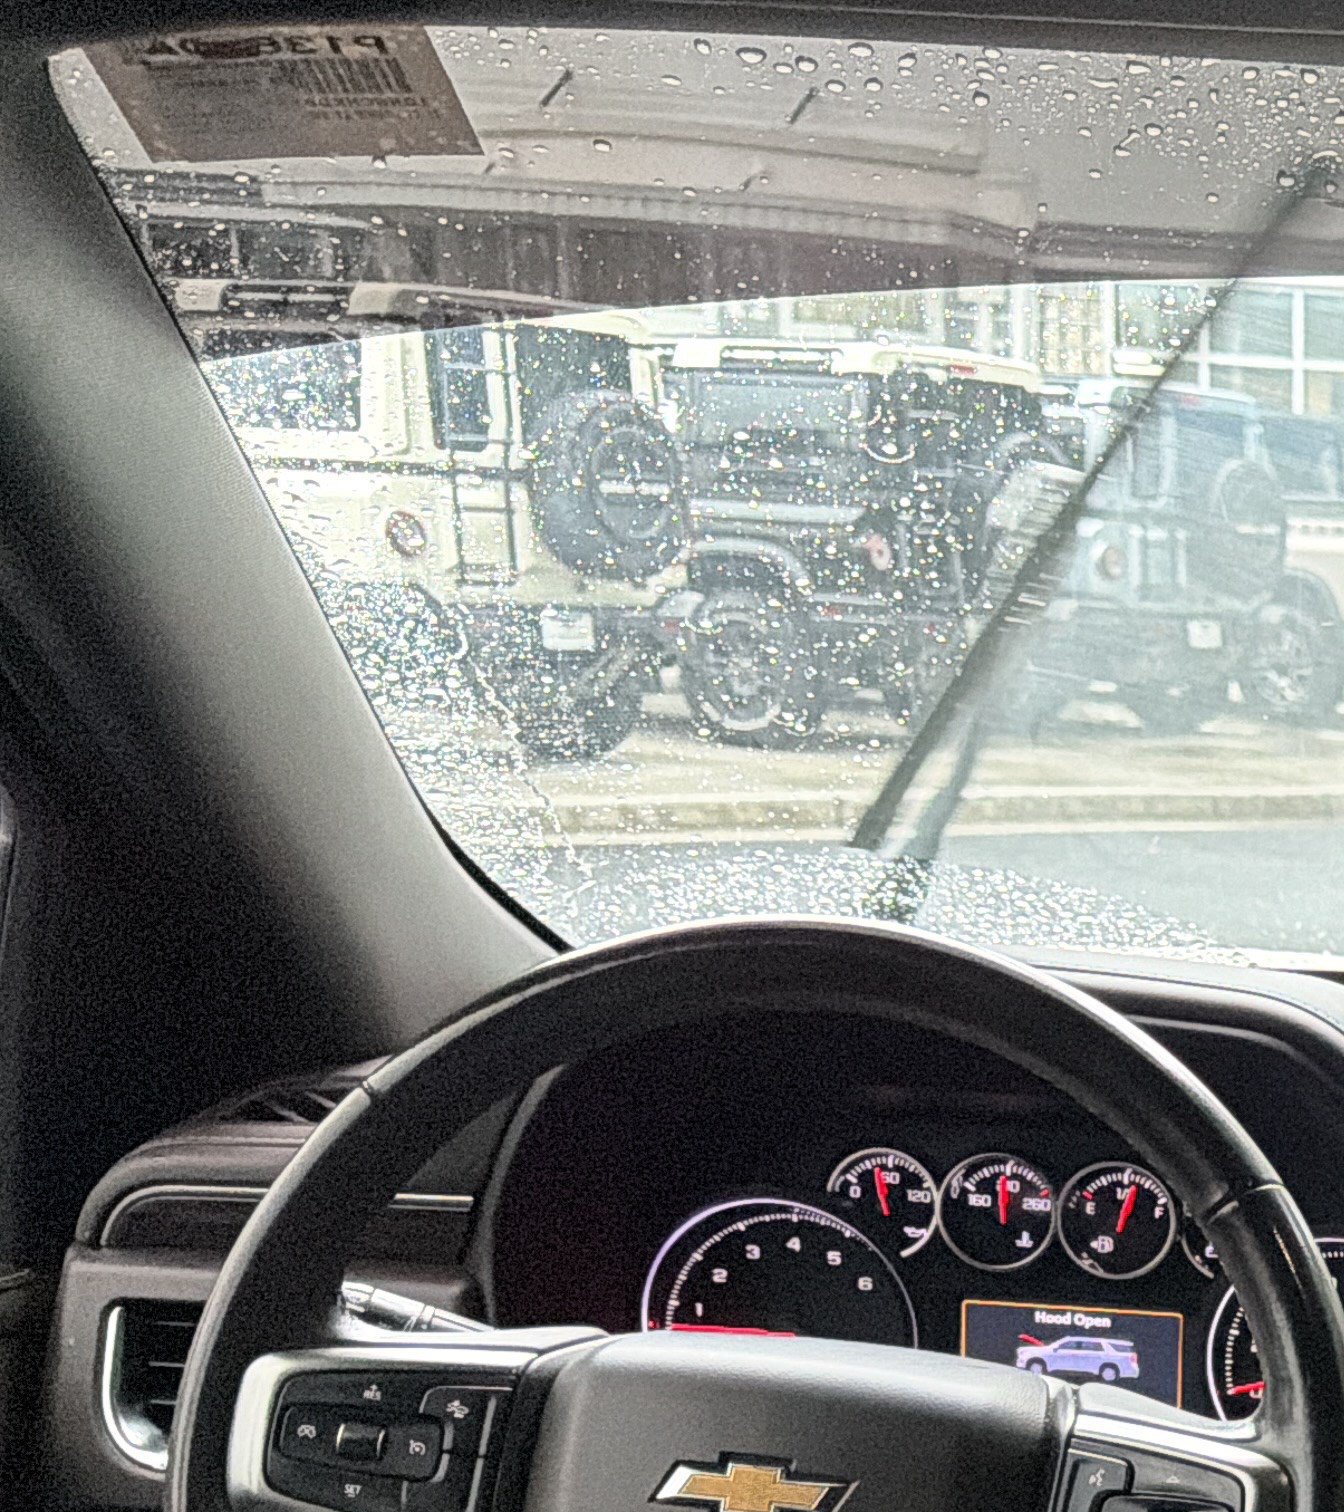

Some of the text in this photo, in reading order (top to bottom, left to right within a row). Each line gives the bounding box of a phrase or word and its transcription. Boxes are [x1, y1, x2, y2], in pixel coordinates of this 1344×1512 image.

[848, 1185, 861, 1199] 0
[906, 1189, 931, 1203] 120
[967, 1195, 992, 1208] 160
[1021, 1197, 1052, 1213] 260
[1085, 1202, 1096, 1215] E
[744, 1243, 761, 1260] 3
[785, 1235, 801, 1253] 4
[825, 1250, 843, 1266] 5
[711, 1267, 729, 1284] 2
[857, 1276, 874, 1292] 6
[694, 1301, 704, 1318] 1
[1034, 1310, 1112, 1331] Hood Open
